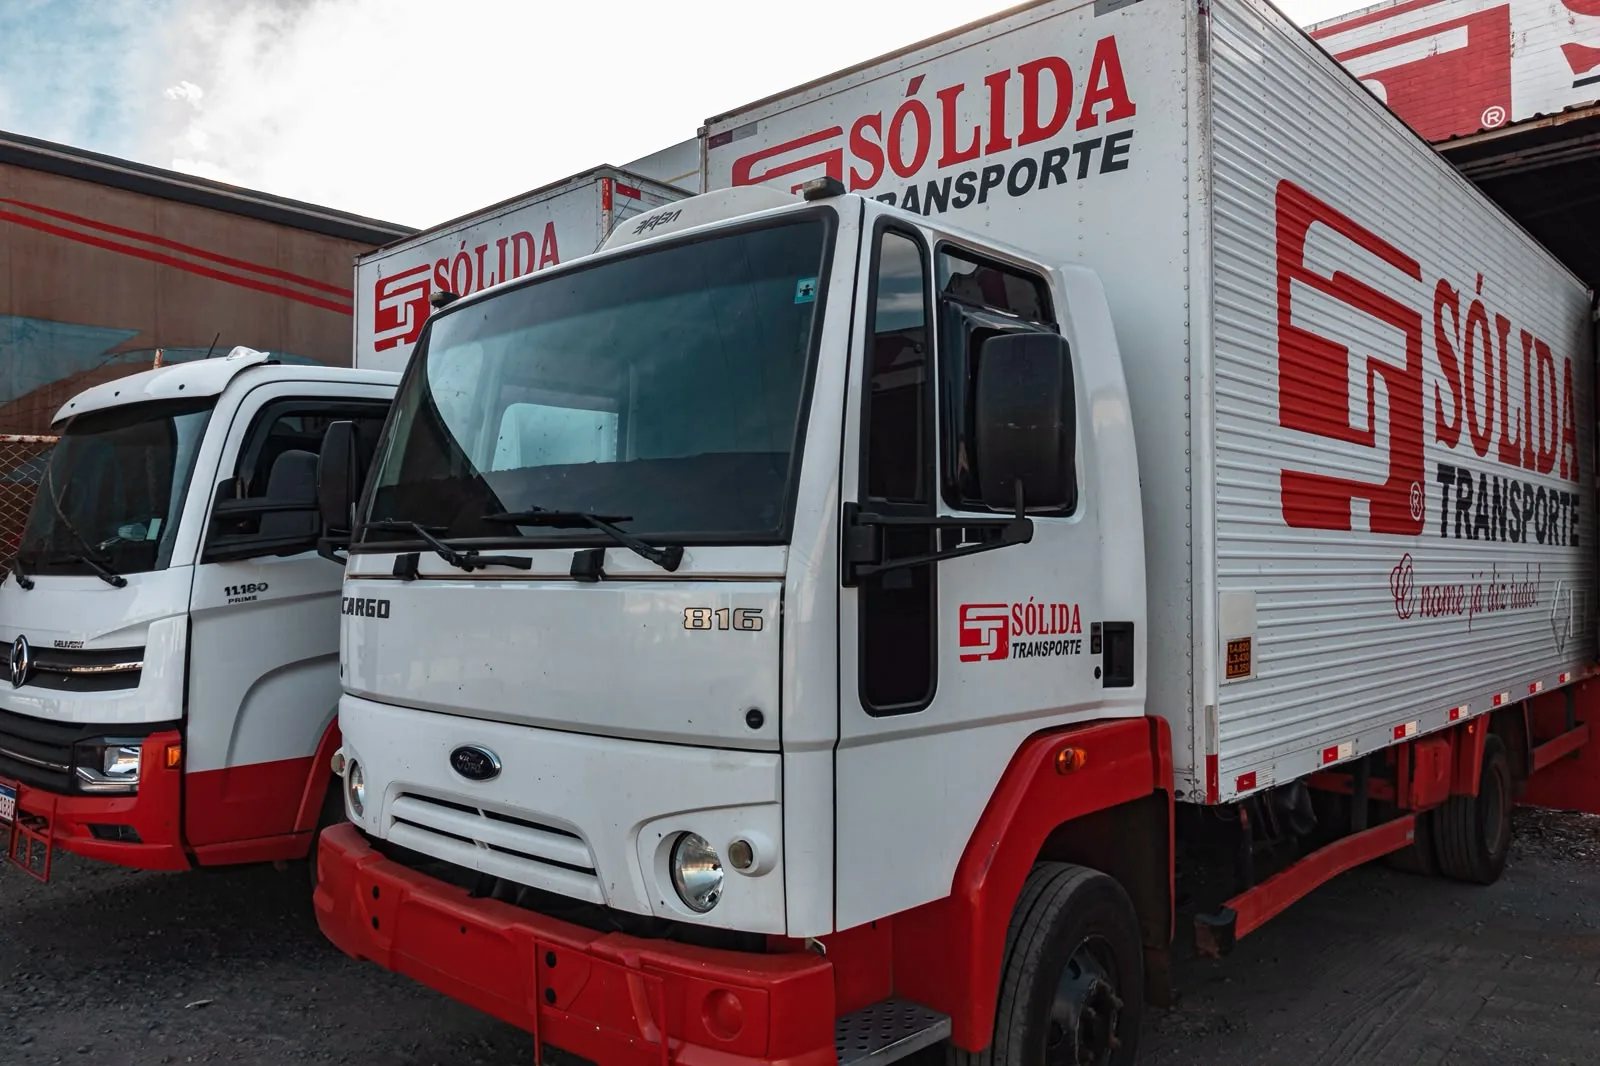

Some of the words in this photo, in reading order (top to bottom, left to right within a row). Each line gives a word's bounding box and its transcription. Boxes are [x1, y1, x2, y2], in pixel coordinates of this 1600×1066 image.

[850, 35, 1136, 191] SÓLIDA
[866, 130, 1134, 216] ANSPORTE
[433, 221, 560, 298] SÓLIDA
[1434, 272, 1580, 482] SÓLIDA
[1437, 463, 1580, 546] TRANSPORTE
[228, 595, 257, 604] PRIME
[342, 597, 391, 619] CARGO
[684, 607, 763, 631] 816
[1012, 596, 1081, 636] SÓLIDA
[1420, 584, 1465, 618] nome
[1012, 639, 1081, 659] TRANSPORTE
